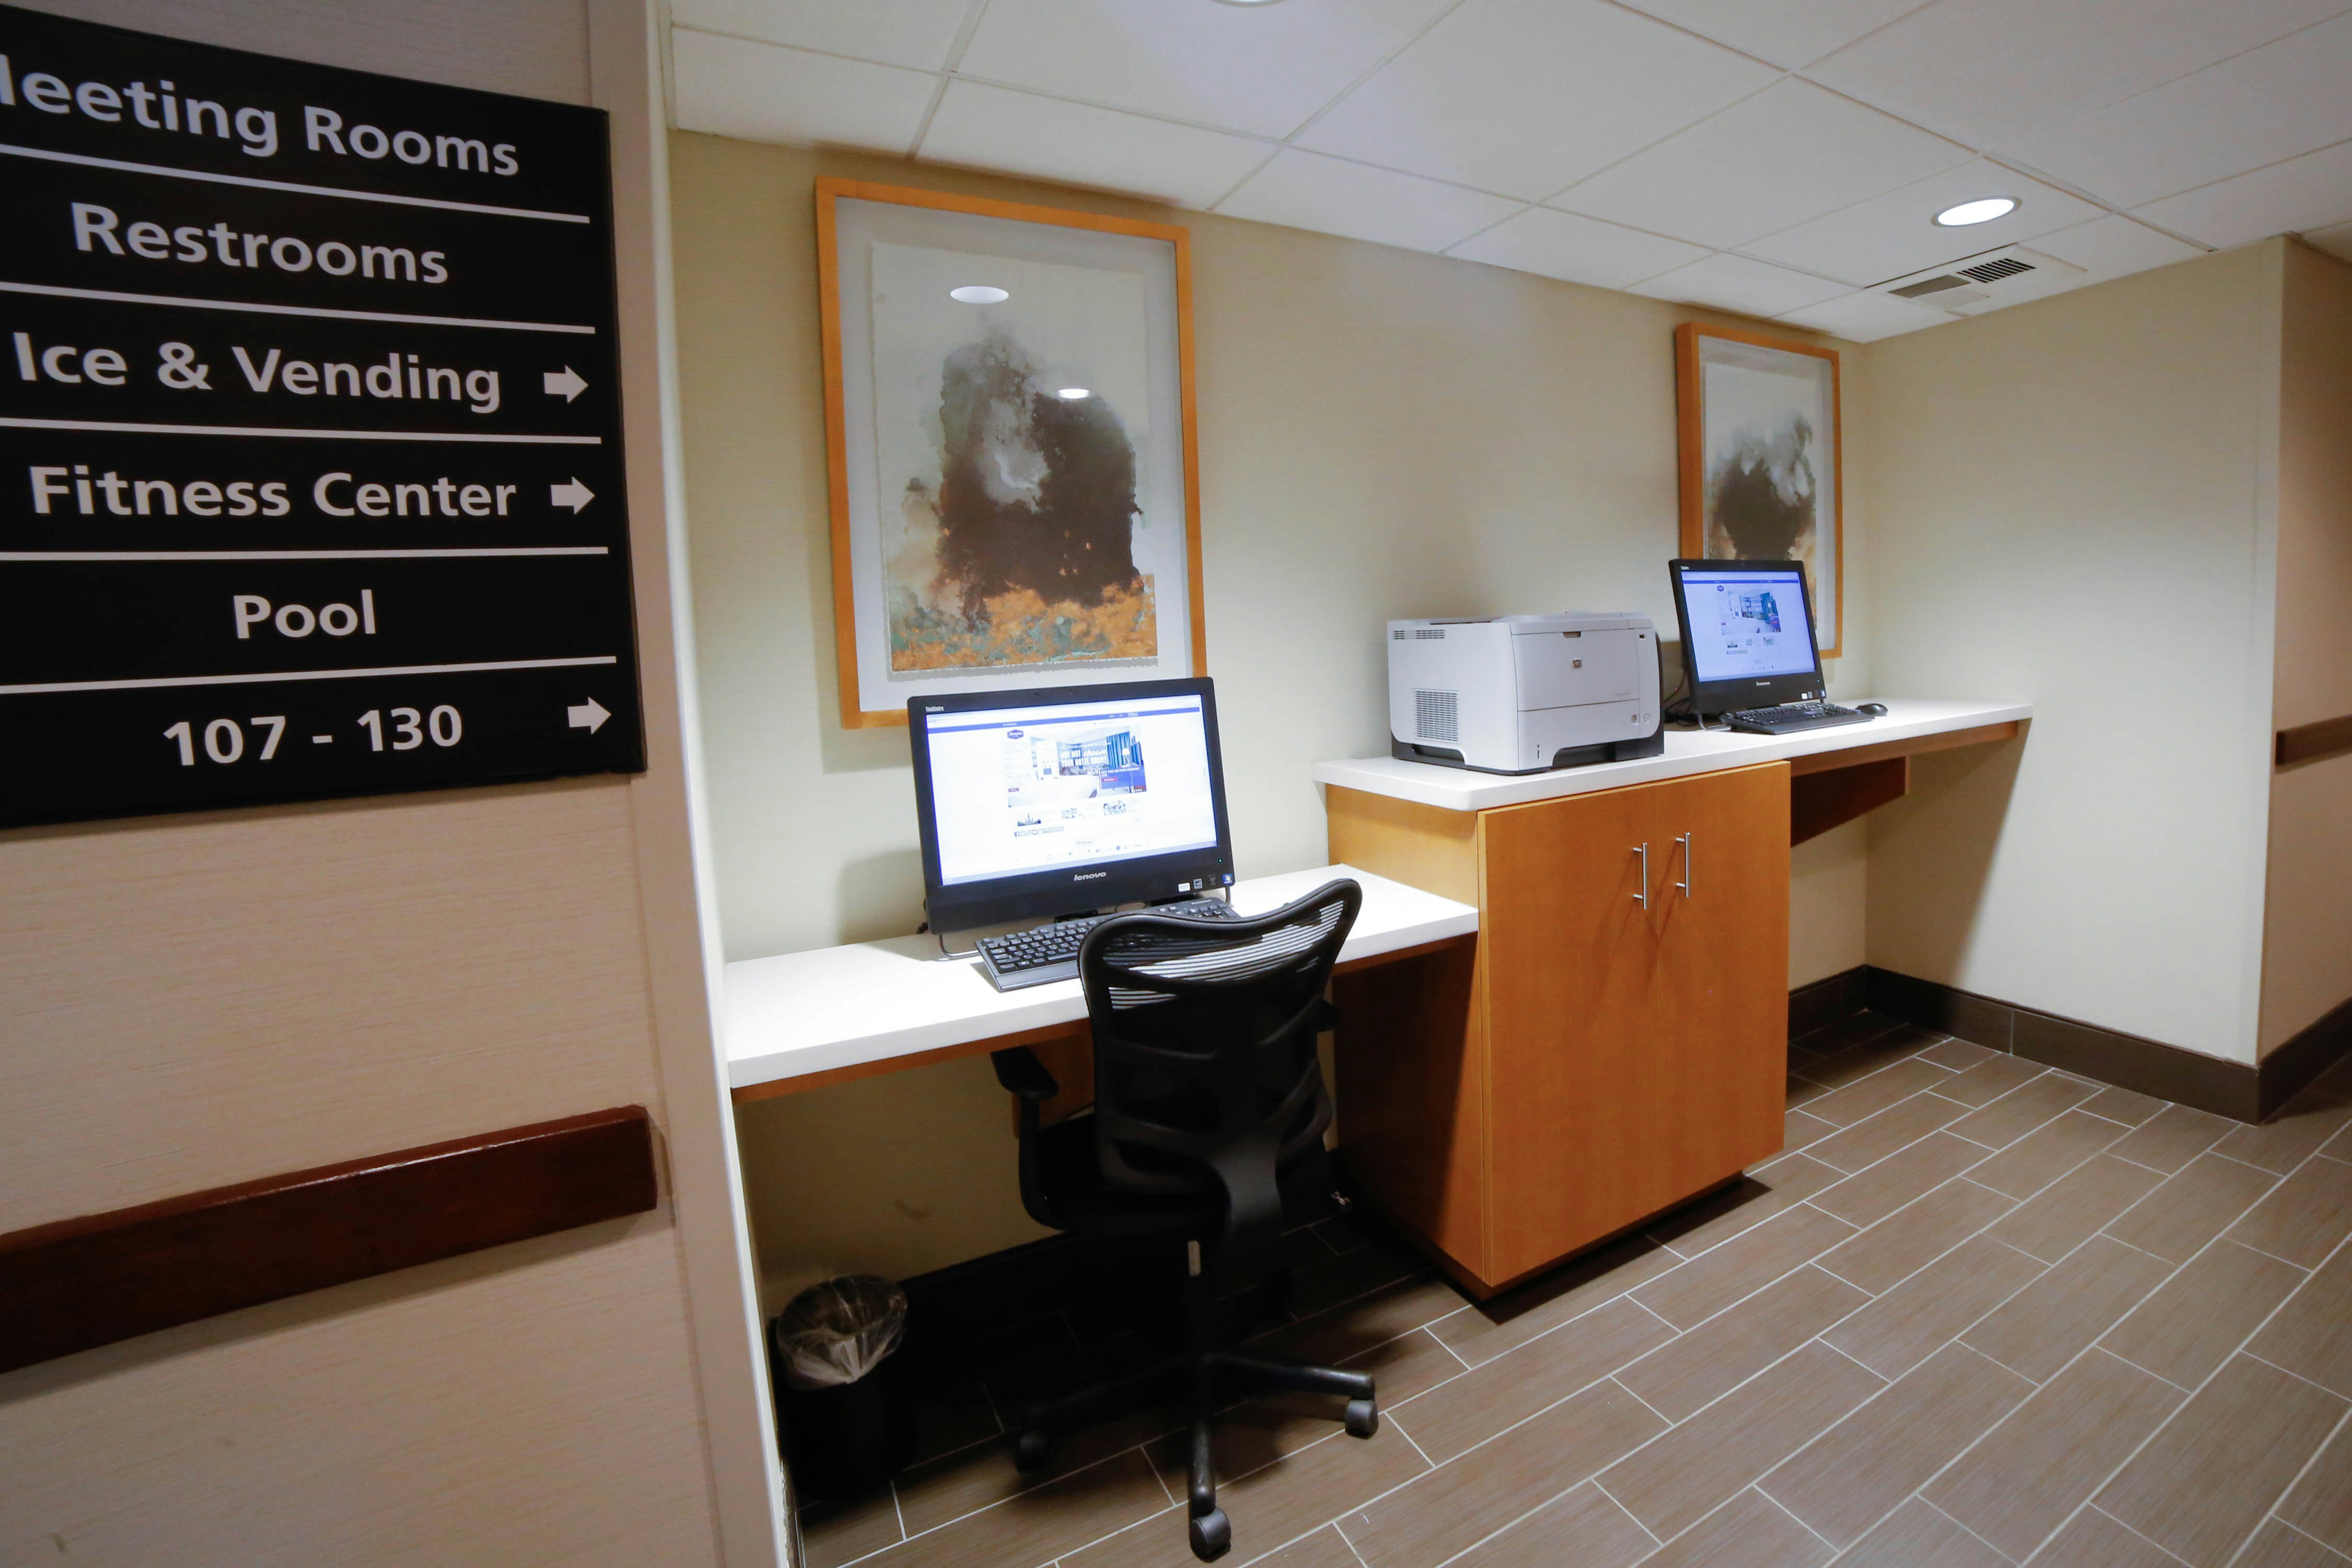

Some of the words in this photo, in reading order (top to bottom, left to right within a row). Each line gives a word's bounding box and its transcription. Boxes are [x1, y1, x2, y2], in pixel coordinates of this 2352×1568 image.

[0, 54, 277, 156] eeting
[305, 106, 517, 176] Rooms
[72, 203, 448, 283] Restrooms
[14, 332, 127, 385] Ice
[158, 342, 212, 390] &
[232, 347, 499, 413] Vending
[30, 465, 290, 516] Fitness
[314, 472, 516, 516] Center
[234, 590, 375, 638] Pool
[164, 716, 285, 765] 107
[313, 735, 332, 743] -
[358, 705, 462, 751] 130
[1071, 750, 1081, 758] NOT
[1074, 872, 1106, 881] lenovo
